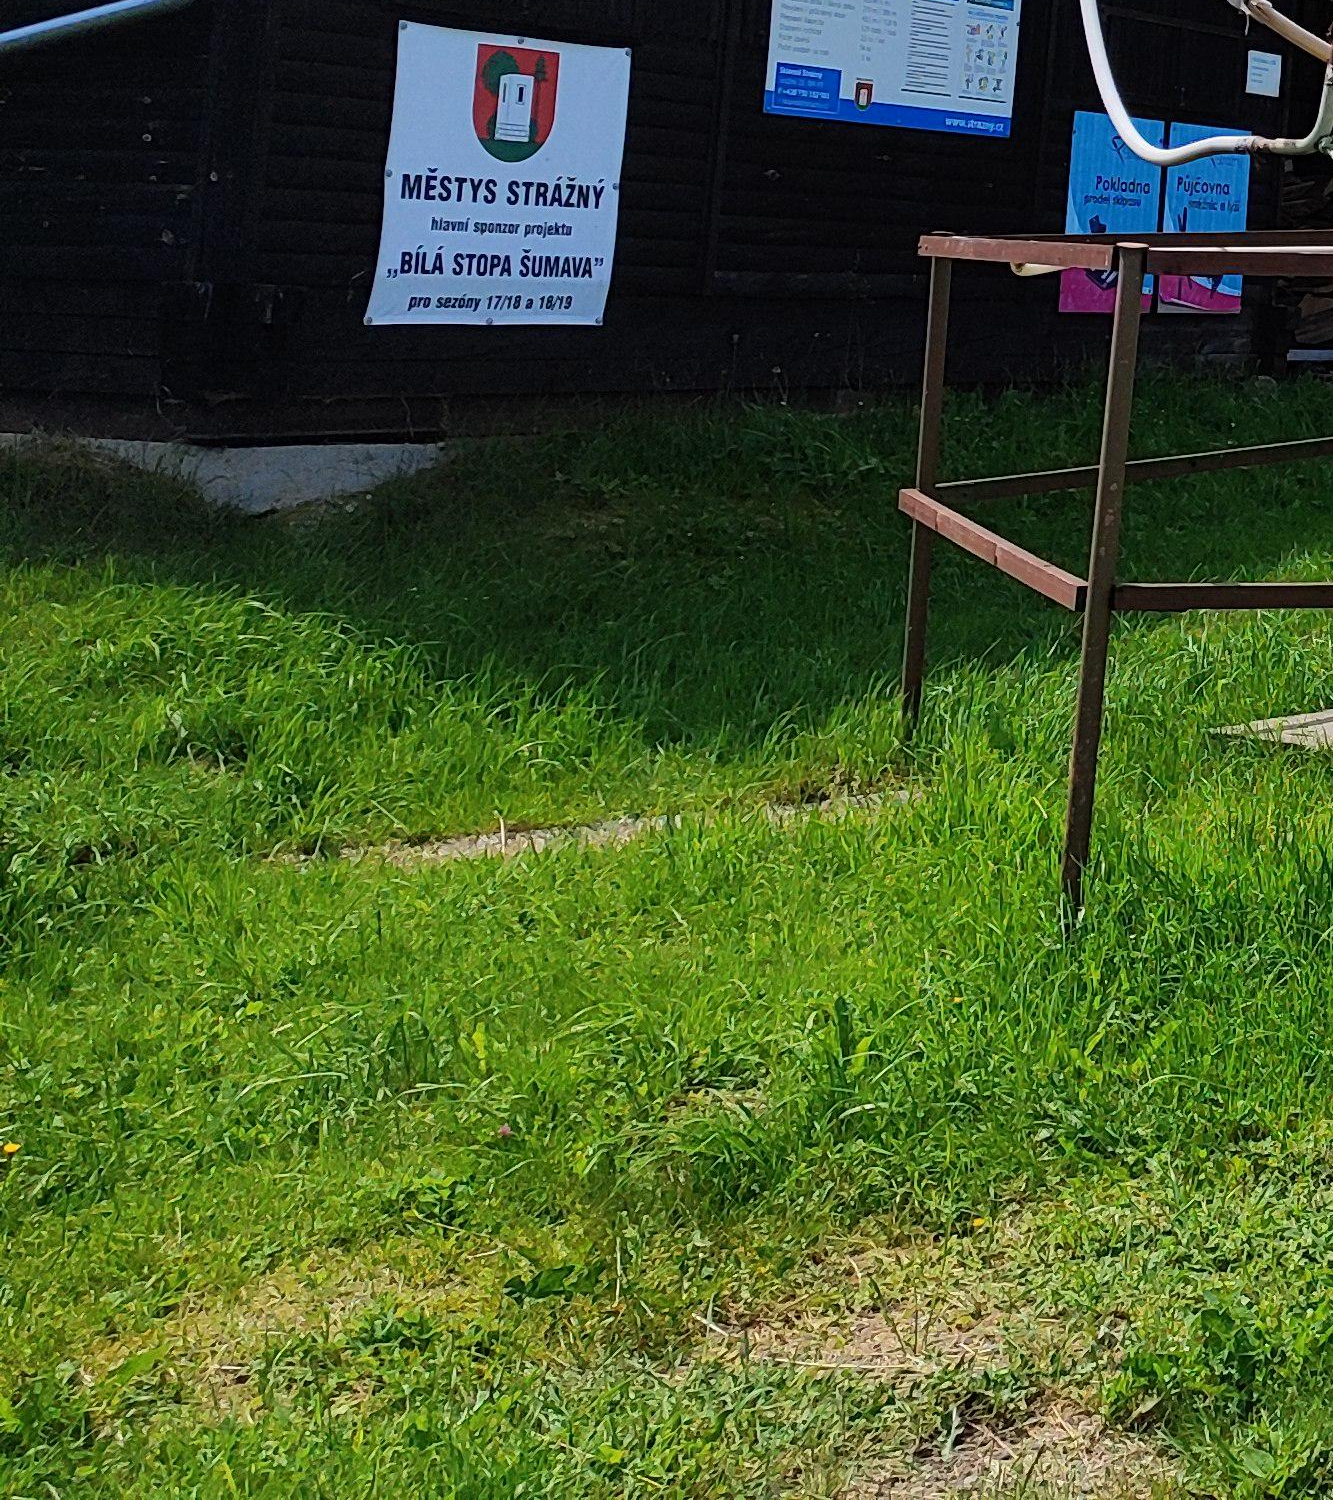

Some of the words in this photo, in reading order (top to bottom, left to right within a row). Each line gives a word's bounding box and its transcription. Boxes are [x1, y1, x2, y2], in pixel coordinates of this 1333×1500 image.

[400, 167, 497, 204] MĚSTYS
[506, 176, 605, 209] STRÁŽNÝ
[1095, 175, 1151, 194] Pokladna
[1177, 174, 1231, 196] Půjčovna
[430, 216, 470, 233] hlavní
[473, 221, 520, 236] sponzor
[524, 221, 572, 239] projektu
[452, 252, 512, 277] STOPA
[407, 296, 431, 311] pro
[435, 293, 481, 311] sezóny
[486, 295, 521, 311] 17/18
[524, 298, 533, 310] a
[538, 295, 573, 311] 18/19
